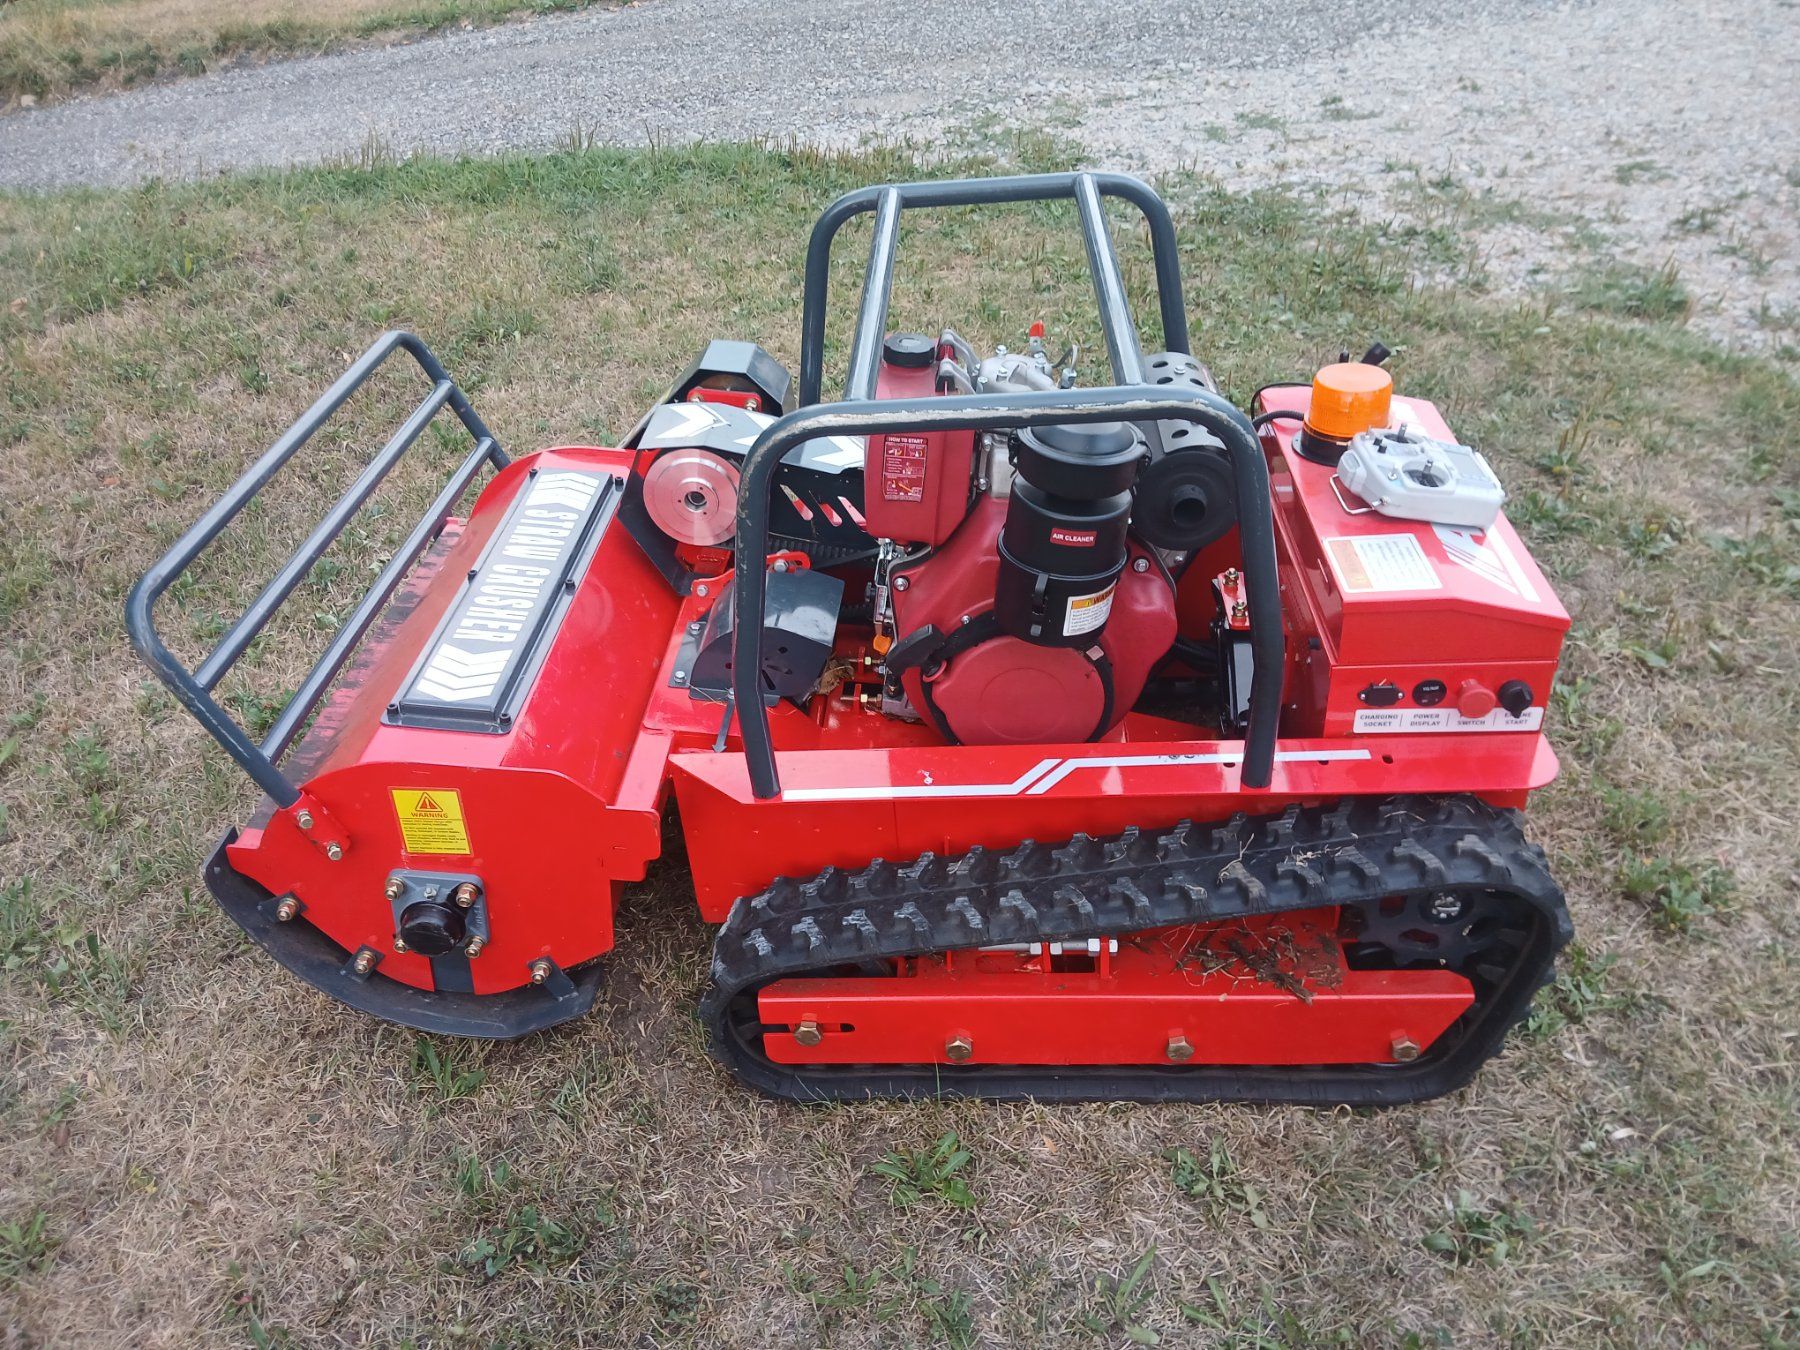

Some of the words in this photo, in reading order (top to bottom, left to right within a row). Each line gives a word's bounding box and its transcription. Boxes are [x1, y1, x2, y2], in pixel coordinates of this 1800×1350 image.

[503, 509, 579, 560] STRAW
[1064, 535, 1094, 543] CLEANER
[452, 564, 551, 642] CRUSHER
